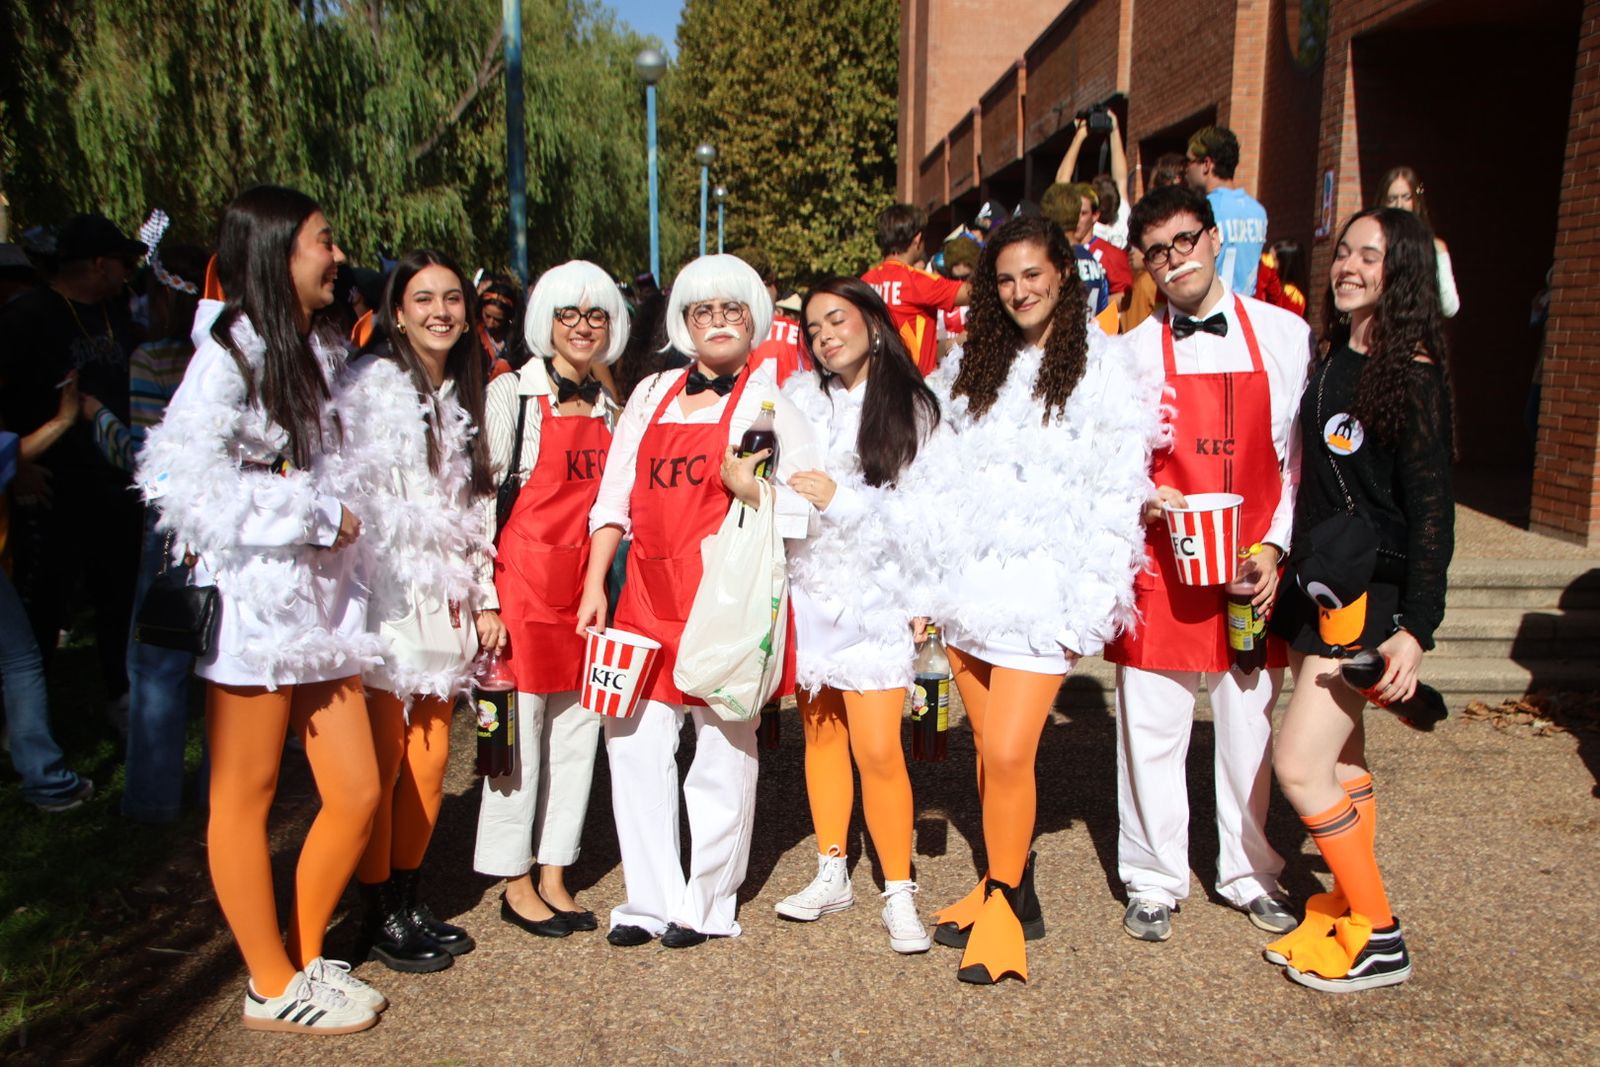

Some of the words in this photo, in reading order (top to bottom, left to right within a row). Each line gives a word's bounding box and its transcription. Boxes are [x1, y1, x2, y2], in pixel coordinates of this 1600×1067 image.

[767, 320, 799, 345] TE
[1195, 438, 1235, 456] KFC
[649, 454, 706, 489] KFC
[591, 667, 627, 690] KFC
